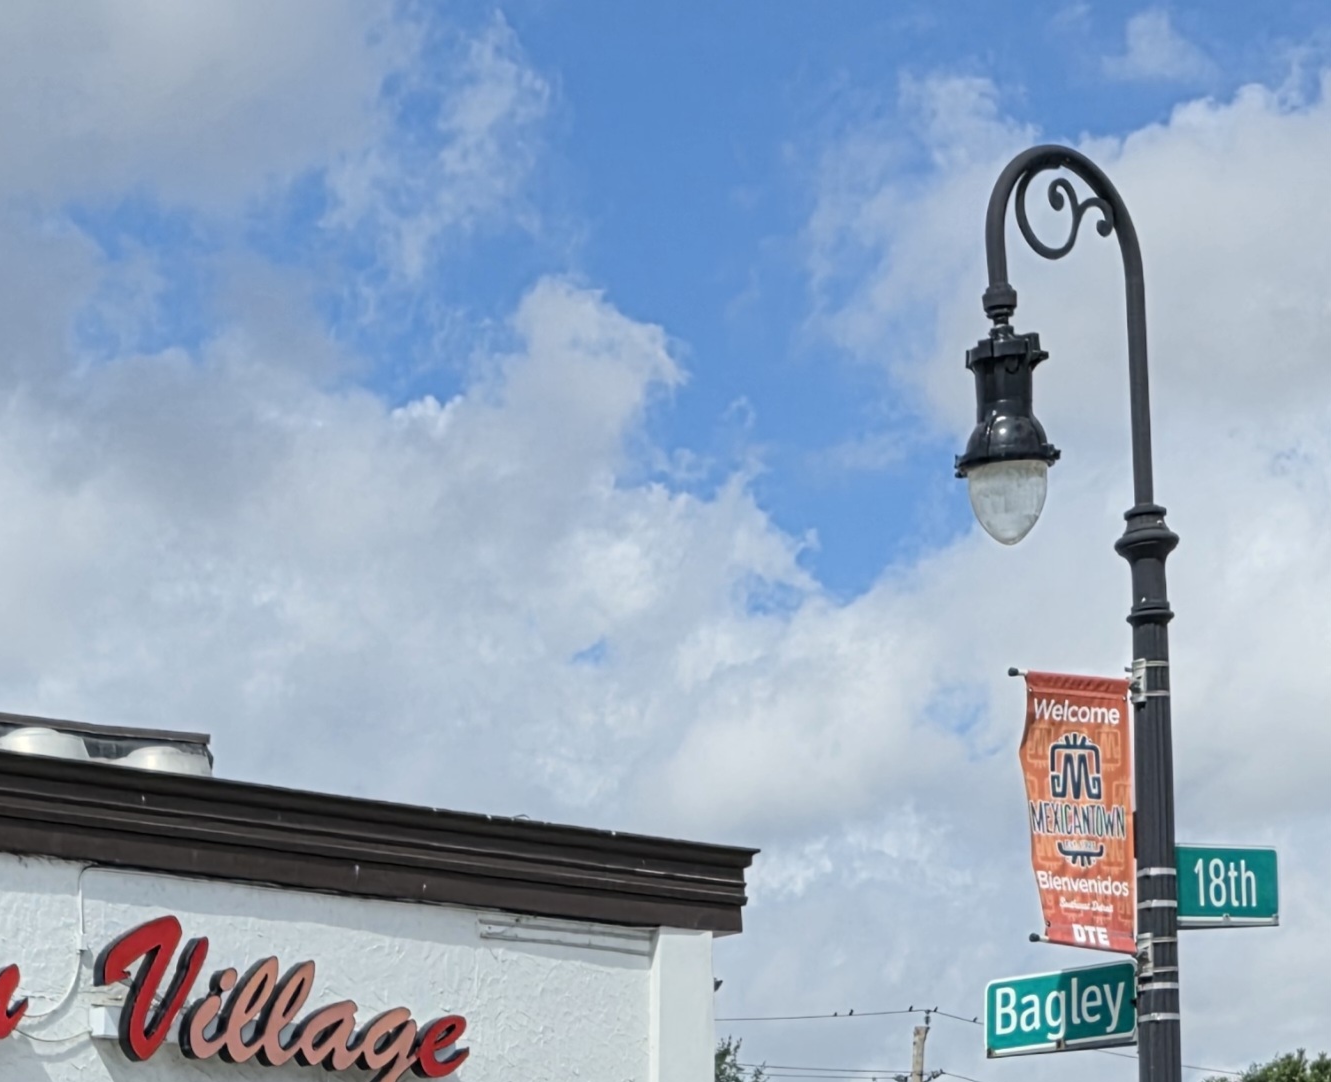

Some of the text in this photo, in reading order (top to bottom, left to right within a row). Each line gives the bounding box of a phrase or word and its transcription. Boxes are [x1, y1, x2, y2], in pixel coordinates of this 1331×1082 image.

[1034, 698, 1120, 724] Welcome
[1030, 800, 1127, 839] MEXICANTOWN
[1036, 870, 1130, 898] Bienvenidos
[1193, 857, 1258, 908] 18th
[1071, 922, 1111, 946] DTE
[995, 977, 1126, 1041] Bagley
